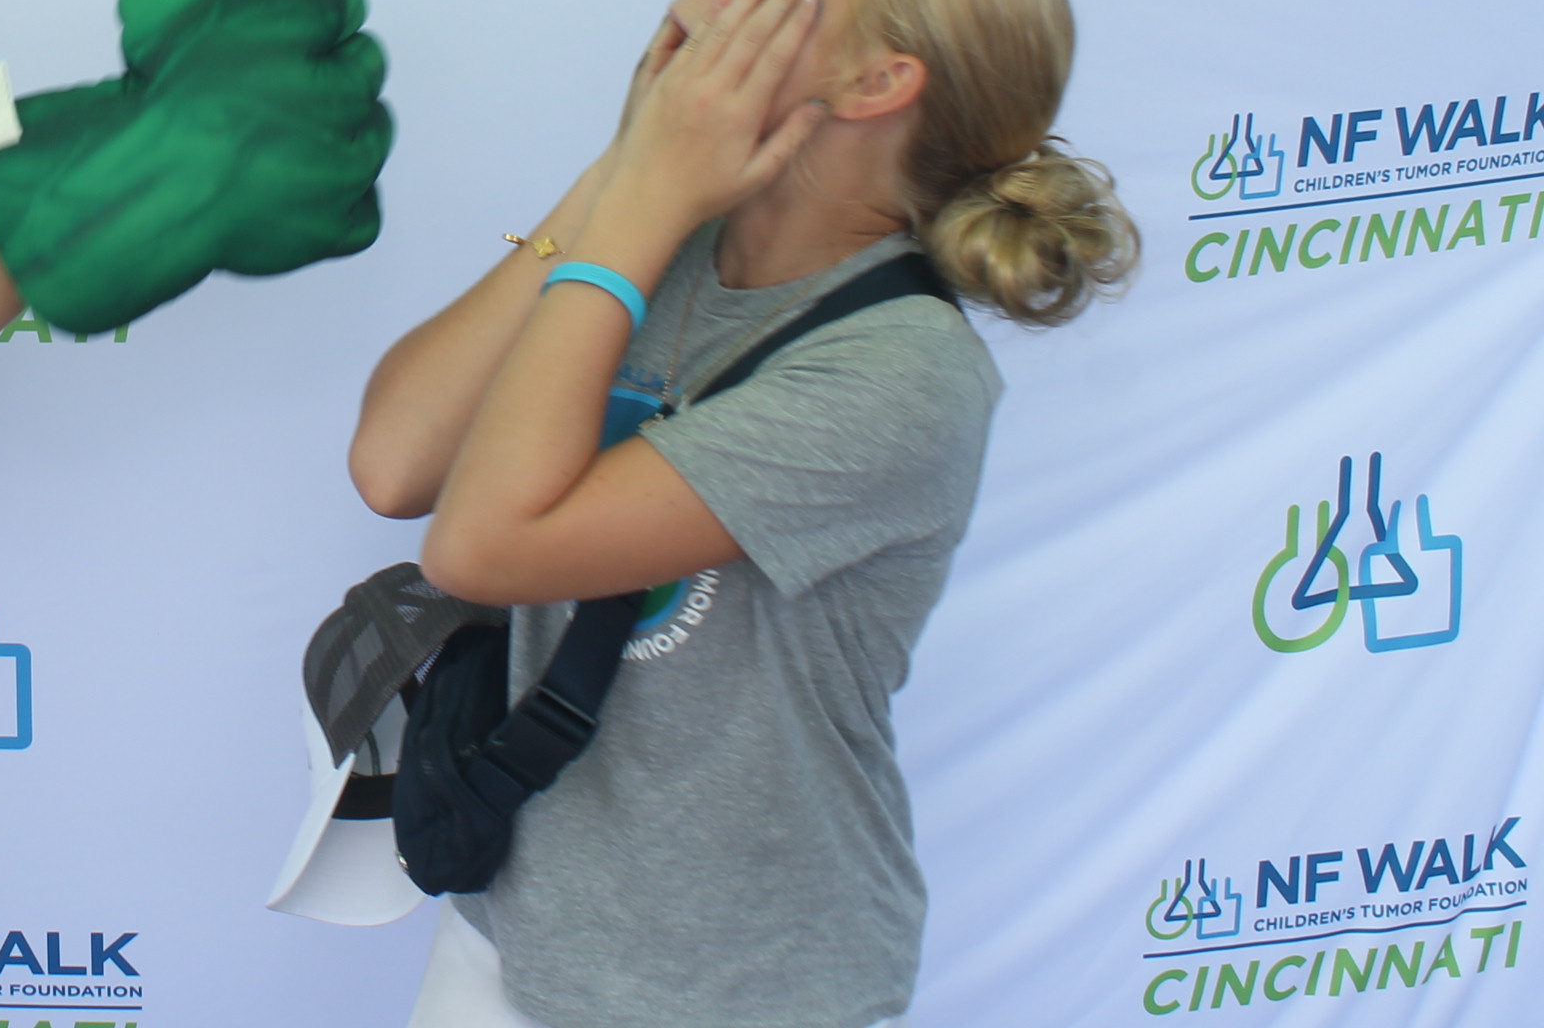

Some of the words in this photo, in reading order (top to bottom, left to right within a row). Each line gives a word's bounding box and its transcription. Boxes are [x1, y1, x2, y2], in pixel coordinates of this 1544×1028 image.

[1297, 109, 1383, 168] NF
[1395, 91, 1544, 156] WALK
[1395, 162, 1452, 182] TUMOR
[1184, 191, 1544, 283] CINCINNATI
[1256, 850, 1343, 909] NF
[1356, 816, 1527, 894] WALK
[1361, 901, 1422, 920] TUMOR
[9, 983, 143, 1000] FOUNDATION
[1142, 920, 1523, 1016] CINCINNATI
